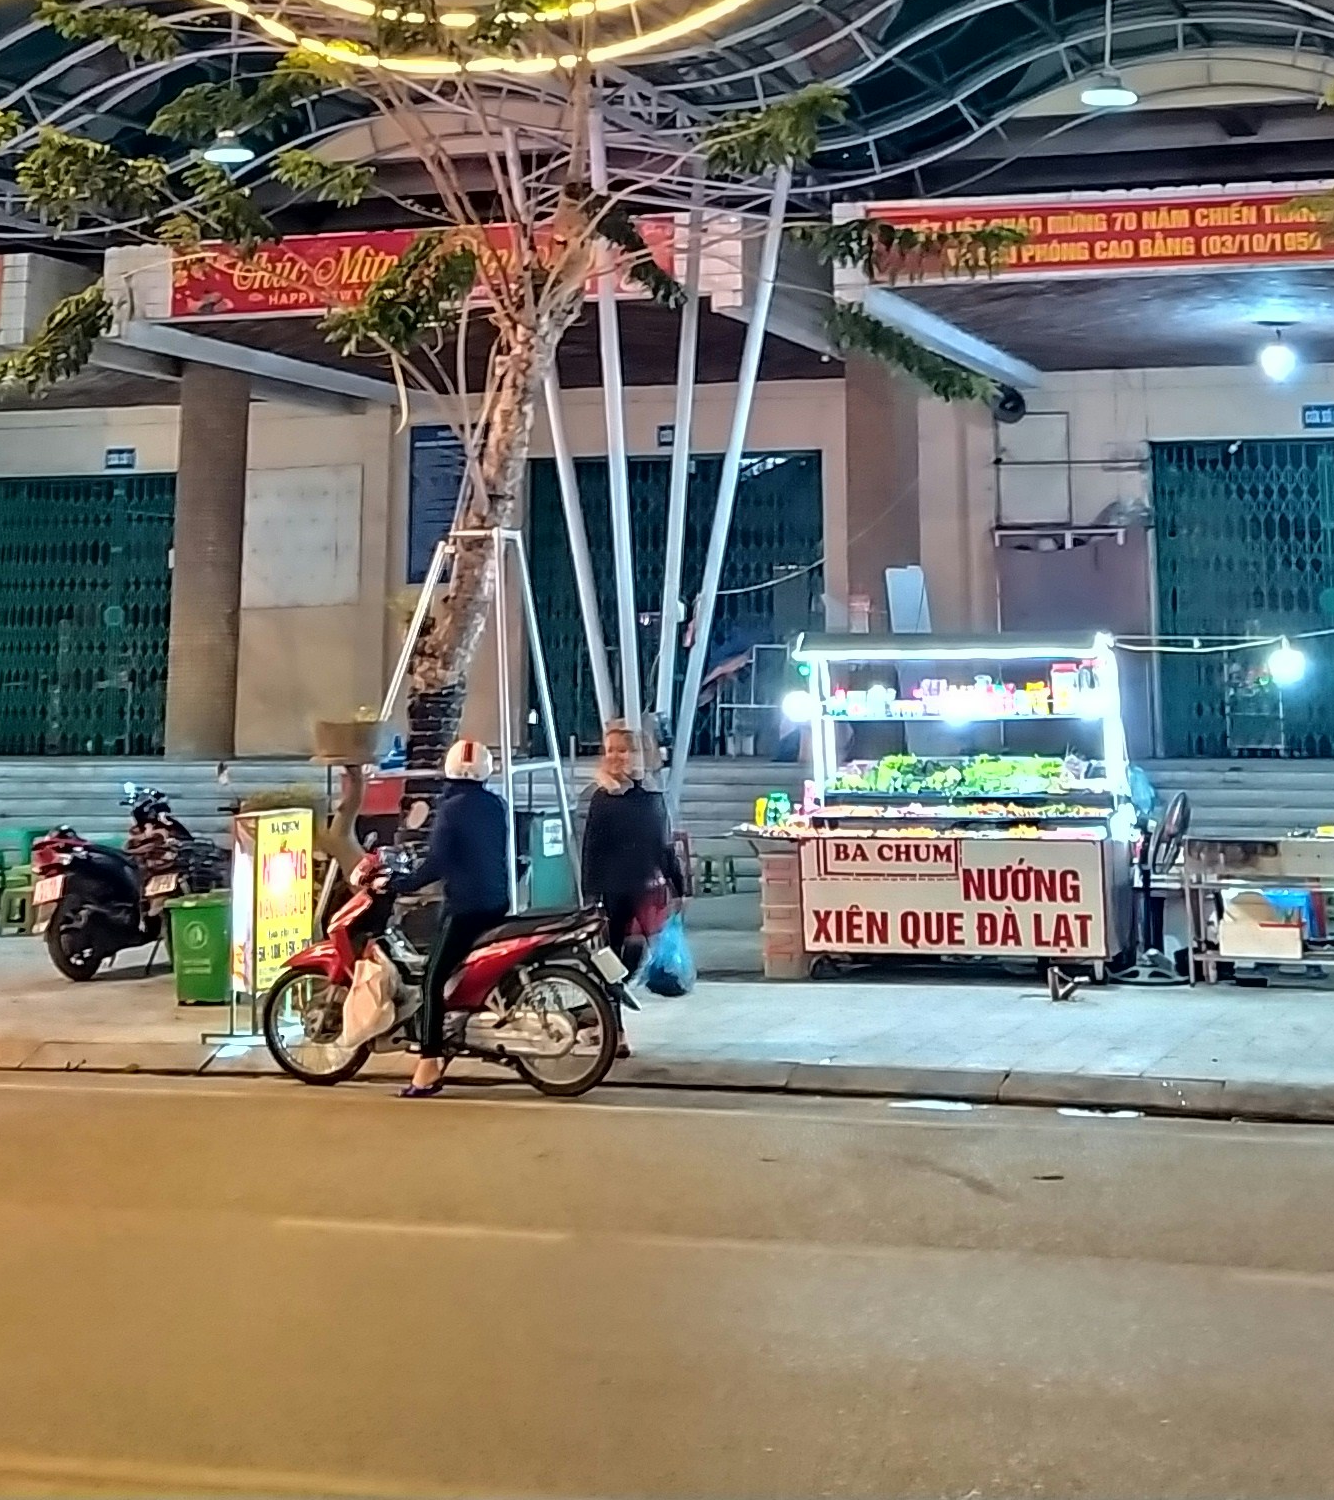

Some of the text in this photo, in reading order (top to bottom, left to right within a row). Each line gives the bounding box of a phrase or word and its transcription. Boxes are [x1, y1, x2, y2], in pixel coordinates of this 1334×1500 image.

[1112, 211, 1137, 232] 70
[1141, 207, 1190, 230] NĂM
[1094, 238, 1135, 260] CAO
[833, 843, 954, 863] BA CHUM
[962, 858, 1081, 904] NƯỚNG
[812, 904, 1094, 954] XIÊN QUE ĐÀ LẠT
